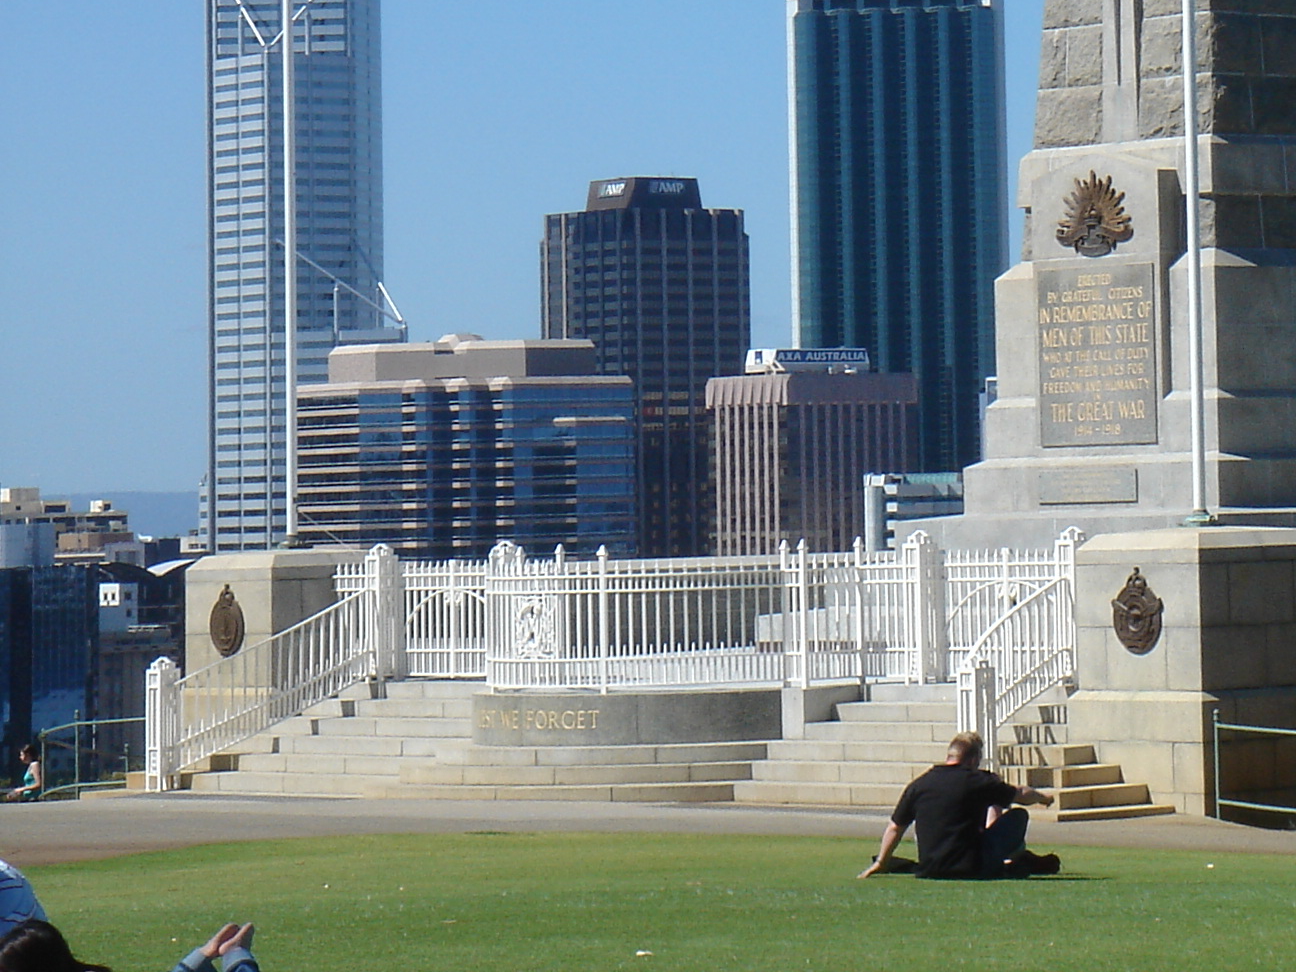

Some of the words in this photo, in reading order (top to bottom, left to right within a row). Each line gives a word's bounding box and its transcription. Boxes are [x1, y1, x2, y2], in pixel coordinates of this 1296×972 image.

[605, 183, 625, 195] AMP
[658, 182, 684, 193] AMP
[1077, 274, 1111, 286] ERECTED
[1047, 291, 1058, 303] BY
[1061, 289, 1103, 302] GRATEFUL
[1108, 286, 1143, 299] CITIZENS
[1040, 308, 1050, 324] IN
[1053, 302, 1134, 323] REMEMBRANCE
[1137, 301, 1152, 318] OF
[1042, 328, 1067, 348] MEN
[1070, 326, 1084, 346] OF
[1088, 325, 1111, 345] THIS
[1115, 323, 1149, 344] STATE
[778, 352, 800, 361] AXA
[805, 351, 866, 361] AUSTRALIA
[1043, 352, 1061, 363] WHO
[1076, 350, 1089, 362] THE
[1093, 349, 1112, 361] CALL
[1115, 348, 1125, 360] OF
[1127, 347, 1149, 359] DUTY
[1049, 366, 1070, 378] GAVE
[1073, 365, 1098, 377] THEIR
[1101, 364, 1124, 377] LIVES
[1127, 363, 1144, 375] FOR
[1043, 381, 1082, 394] FREEDOM
[1086, 380, 1101, 392] AND
[1105, 378, 1149, 391] HUMANITY
[1050, 402, 1073, 423] THE
[1077, 401, 1114, 421] GREAT
[1118, 399, 1145, 419] WAR
[500, 710, 519, 729] WE
[525, 709, 599, 729] FORGET
